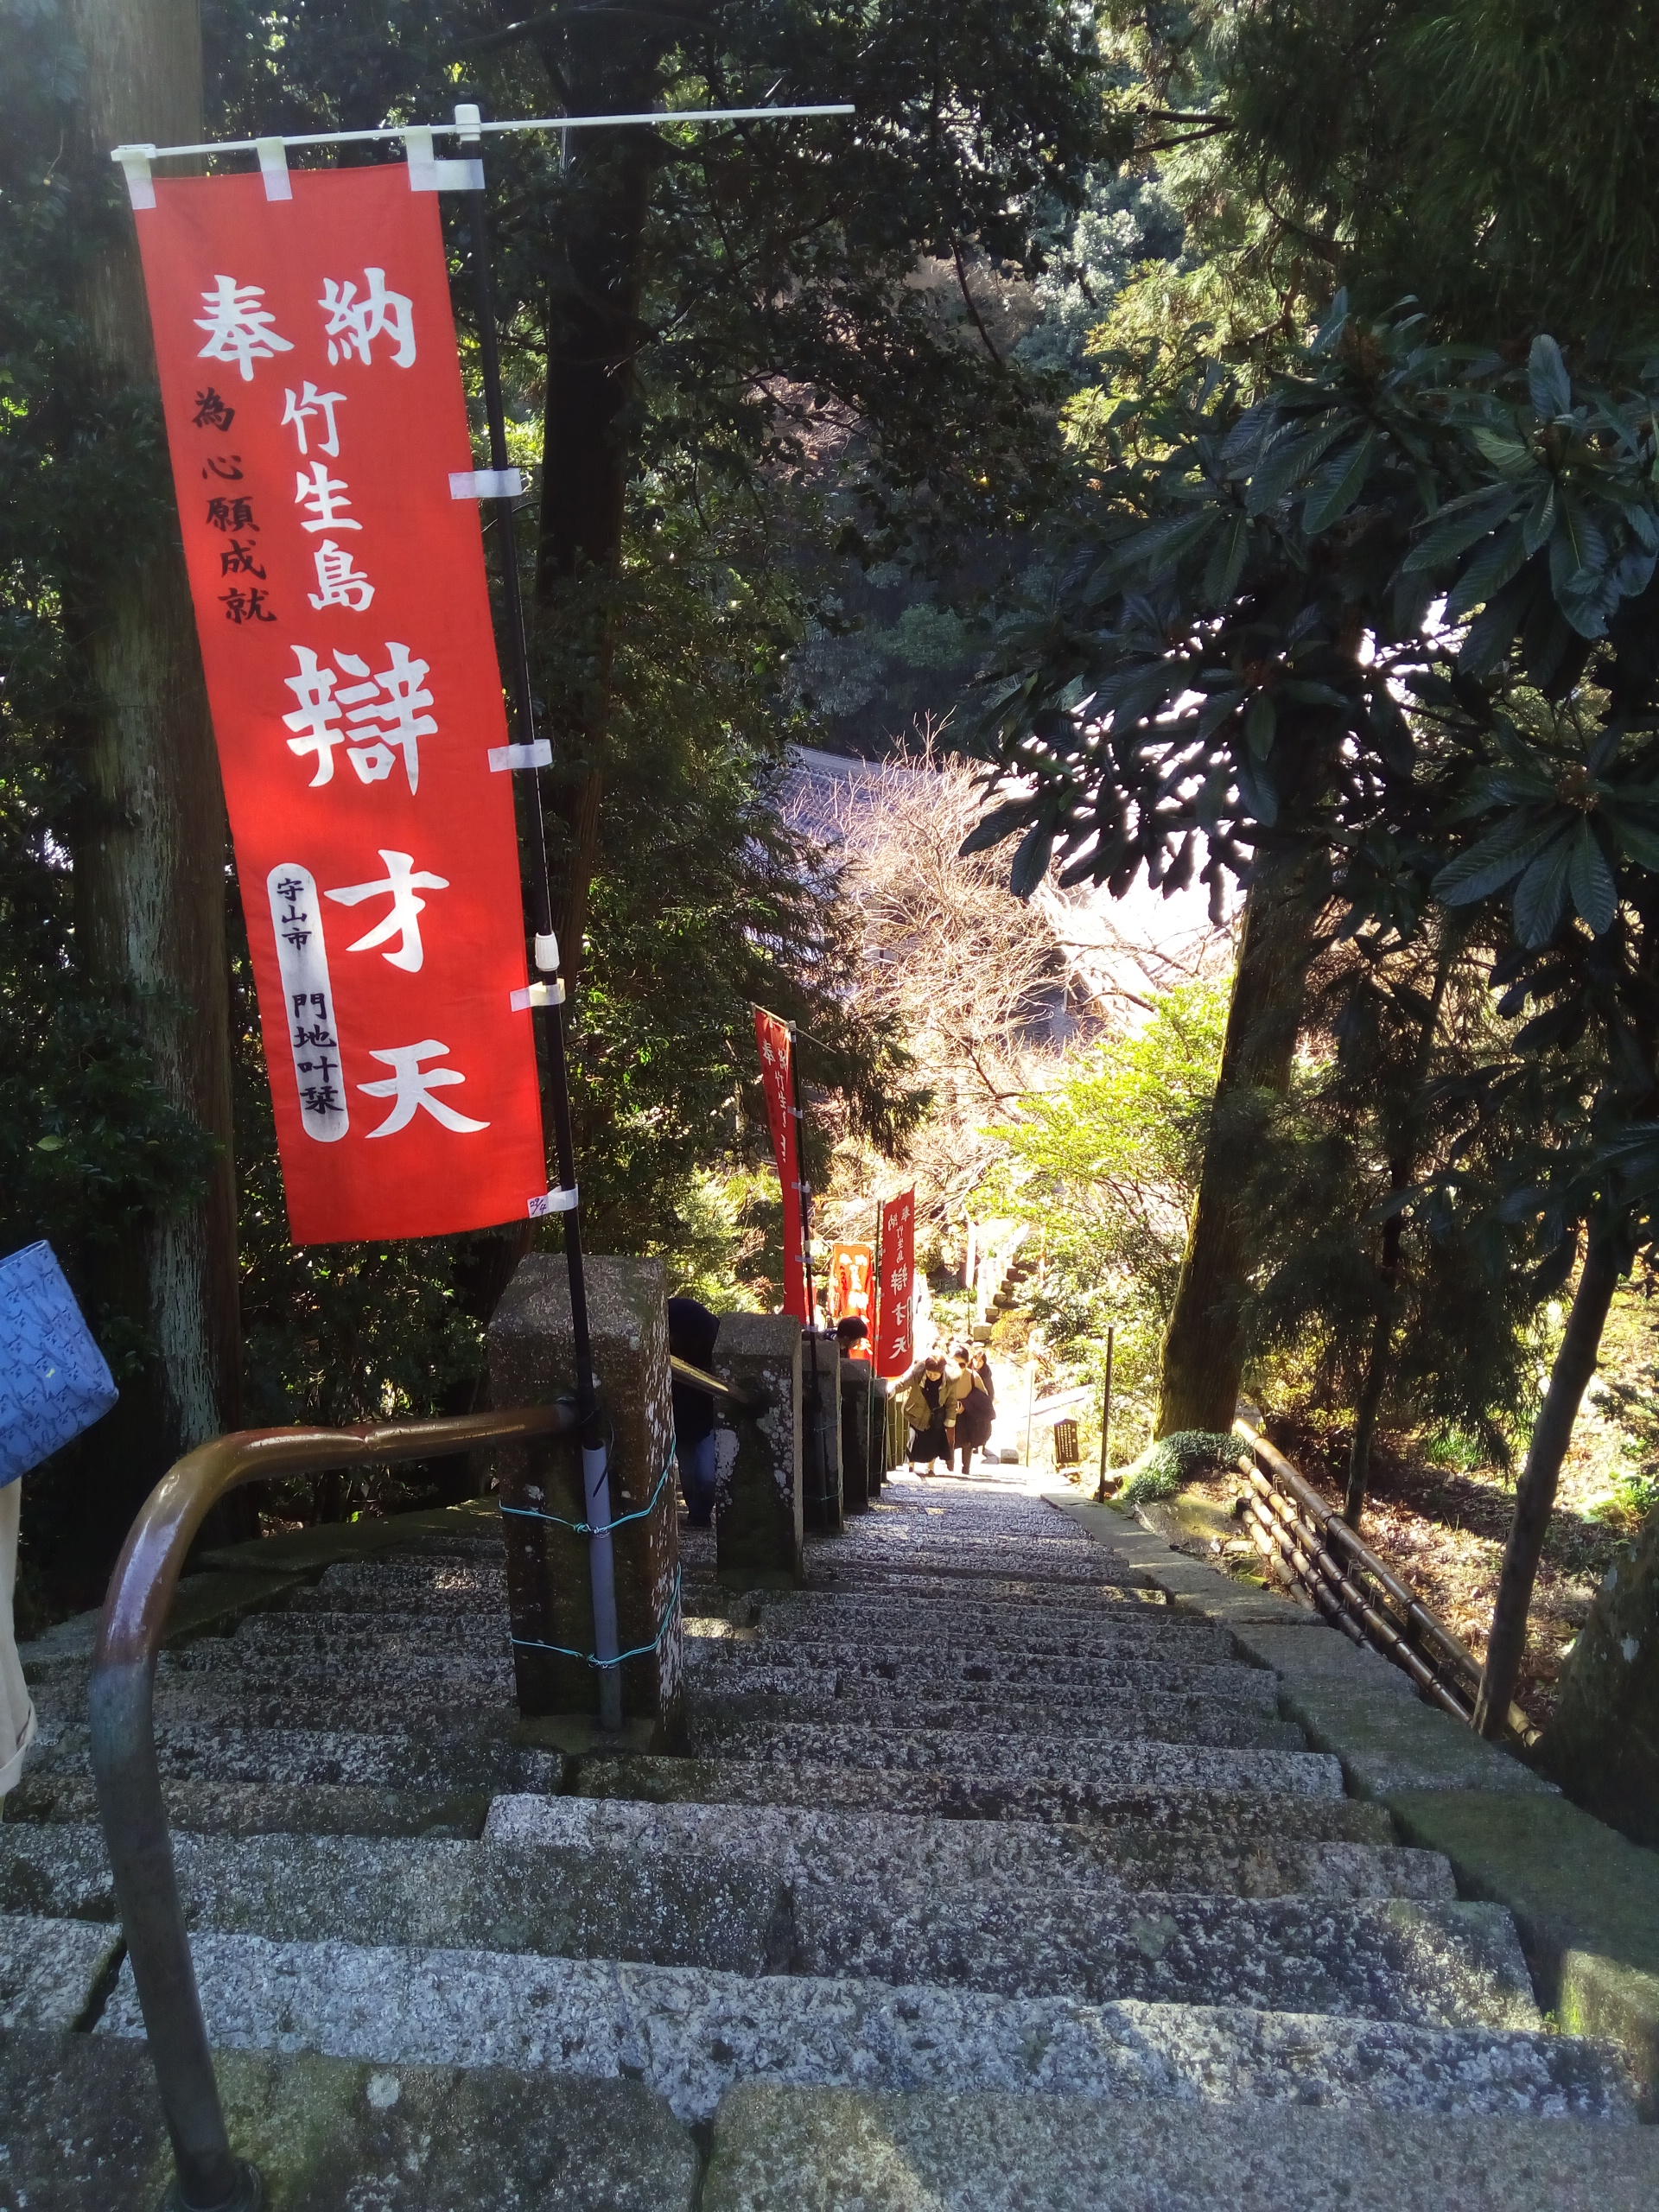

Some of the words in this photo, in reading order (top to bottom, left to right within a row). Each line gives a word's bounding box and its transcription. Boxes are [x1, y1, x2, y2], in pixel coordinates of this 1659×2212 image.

[194, 267, 416, 382] 奉納
[276, 878, 312, 951] 守山市
